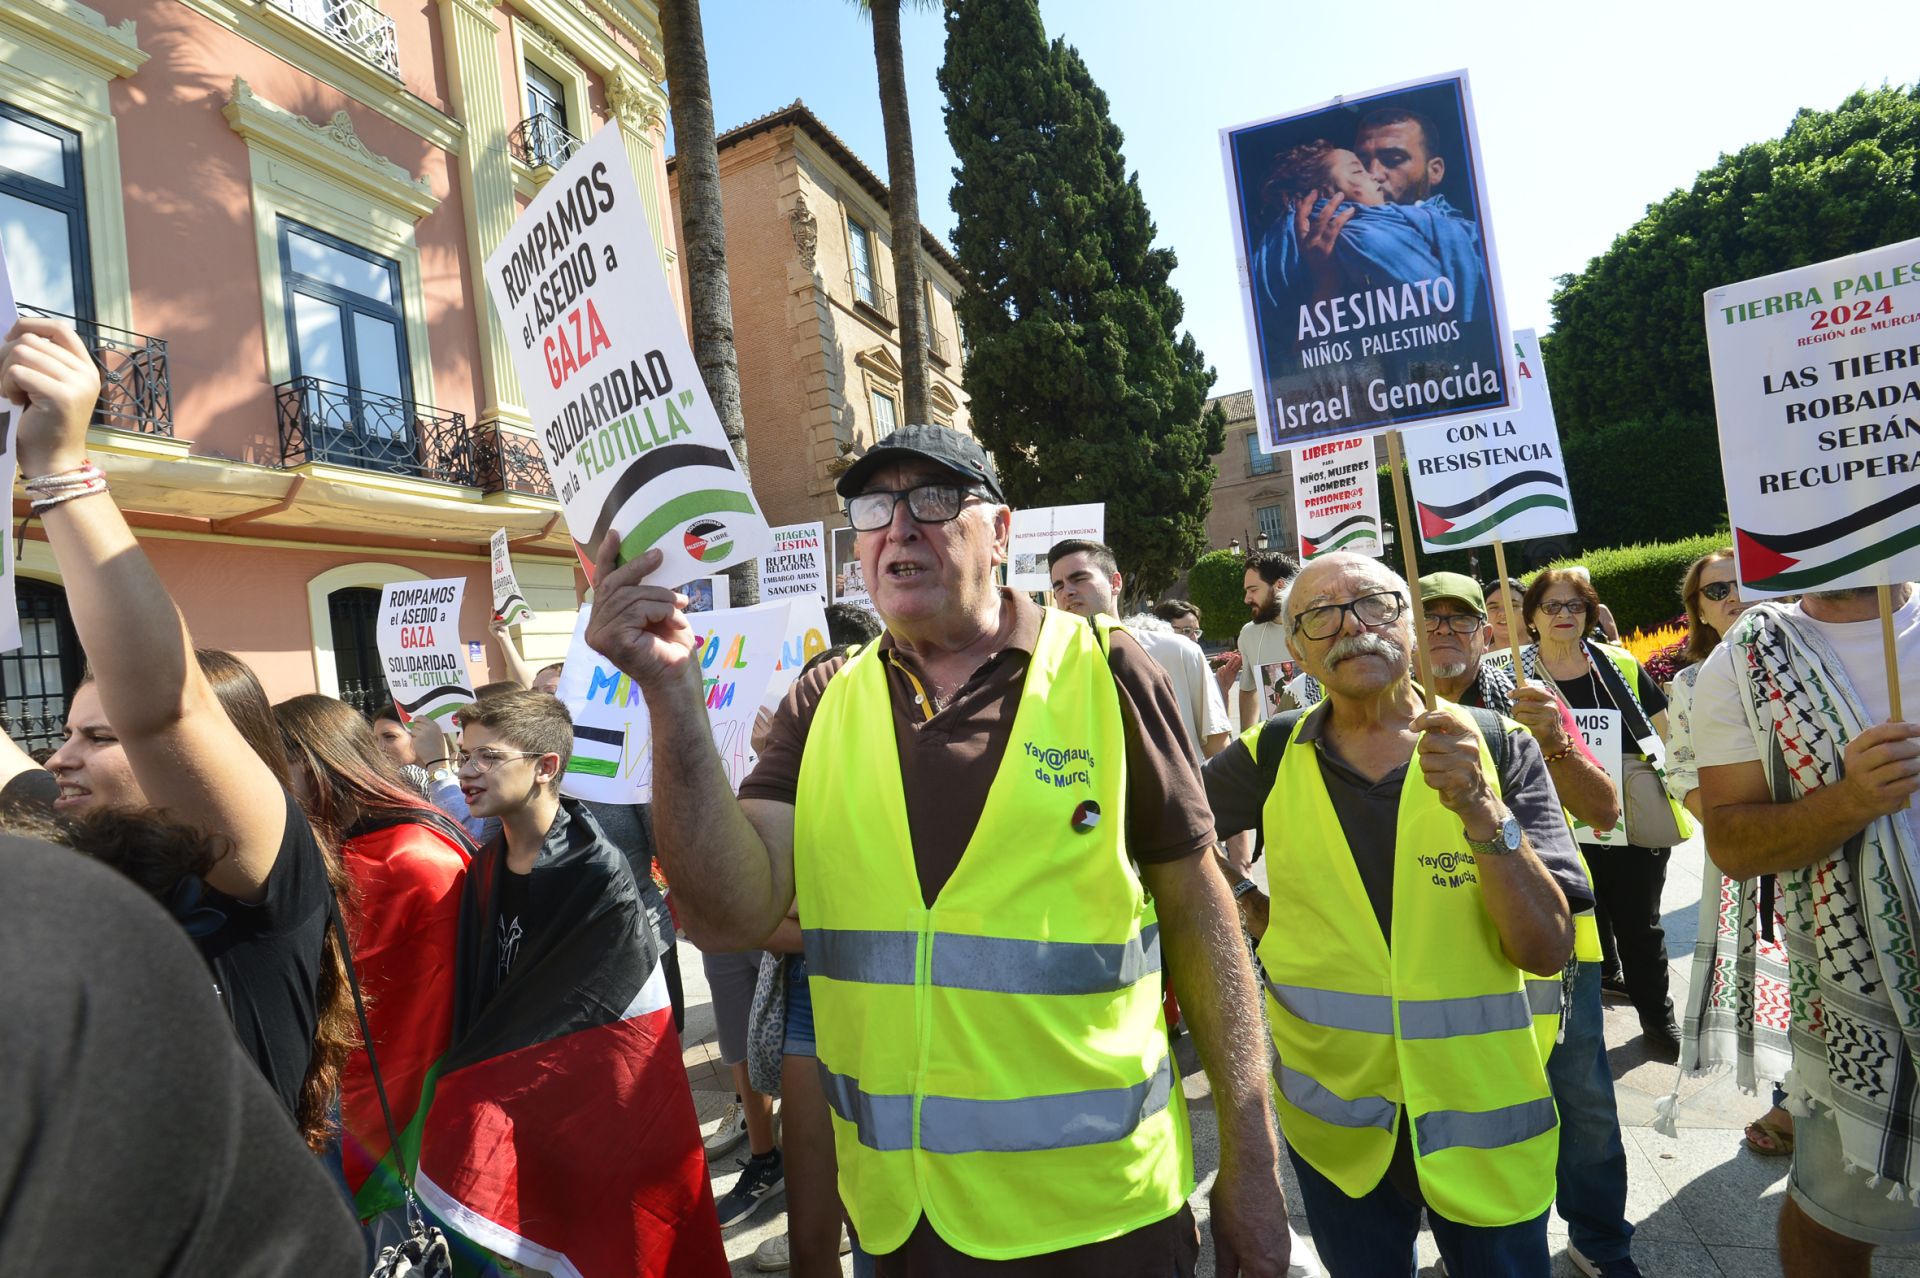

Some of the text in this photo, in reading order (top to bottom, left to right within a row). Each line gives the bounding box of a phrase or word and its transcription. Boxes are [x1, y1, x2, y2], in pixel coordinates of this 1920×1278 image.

[501, 161, 615, 309] ROMPAMOS
[523, 242, 618, 350] el ASEDIO a
[1721, 286, 1823, 325] TIERRA
[1298, 276, 1455, 341] ASESINATO
[1810, 295, 1894, 331] 2024
[543, 297, 612, 390] GAZA
[1301, 319, 1460, 369] NIÑOS PALESTINOS
[1797, 329, 1845, 347] REGIÓN
[1850, 325, 1866, 336] de
[1763, 366, 1819, 395] LAS
[1276, 362, 1500, 430] Israel Genocida
[545, 349, 673, 467] SOLIDARIDAD
[1446, 420, 1516, 443] CON LA
[1302, 437, 1363, 461] LIBERTAD
[1418, 442, 1552, 476] RESISTENCIA
[1300, 460, 1369, 484] NIÑOS, MUJERES
[561, 482, 574, 505] con
[569, 470, 580, 494] la
[1313, 476, 1356, 494] HOMBRES
[1304, 487, 1363, 507] PRISIONER@S
[1309, 500, 1362, 519] PALESTIN@S
[710, 532, 729, 542] LIBRE
[774, 528, 817, 541] RTAGENA
[765, 552, 815, 567] RUPTURA
[766, 562, 816, 574] RELACIONES
[763, 572, 820, 584] EMBARGO ARMAS
[767, 583, 817, 596] SANCIONES
[390, 586, 456, 608] ROMPAMOS
[390, 607, 446, 625] el ASEDIO a
[400, 625, 436, 649] GAZA
[722, 633, 748, 669] AL
[388, 654, 457, 673] SOLIDARIDAD
[703, 674, 735, 710] TINA
[1575, 715, 1609, 730] MOS
[1595, 737, 1602, 746] a
[1035, 768, 1091, 788] de Murci
[1432, 874, 1446, 887] de
